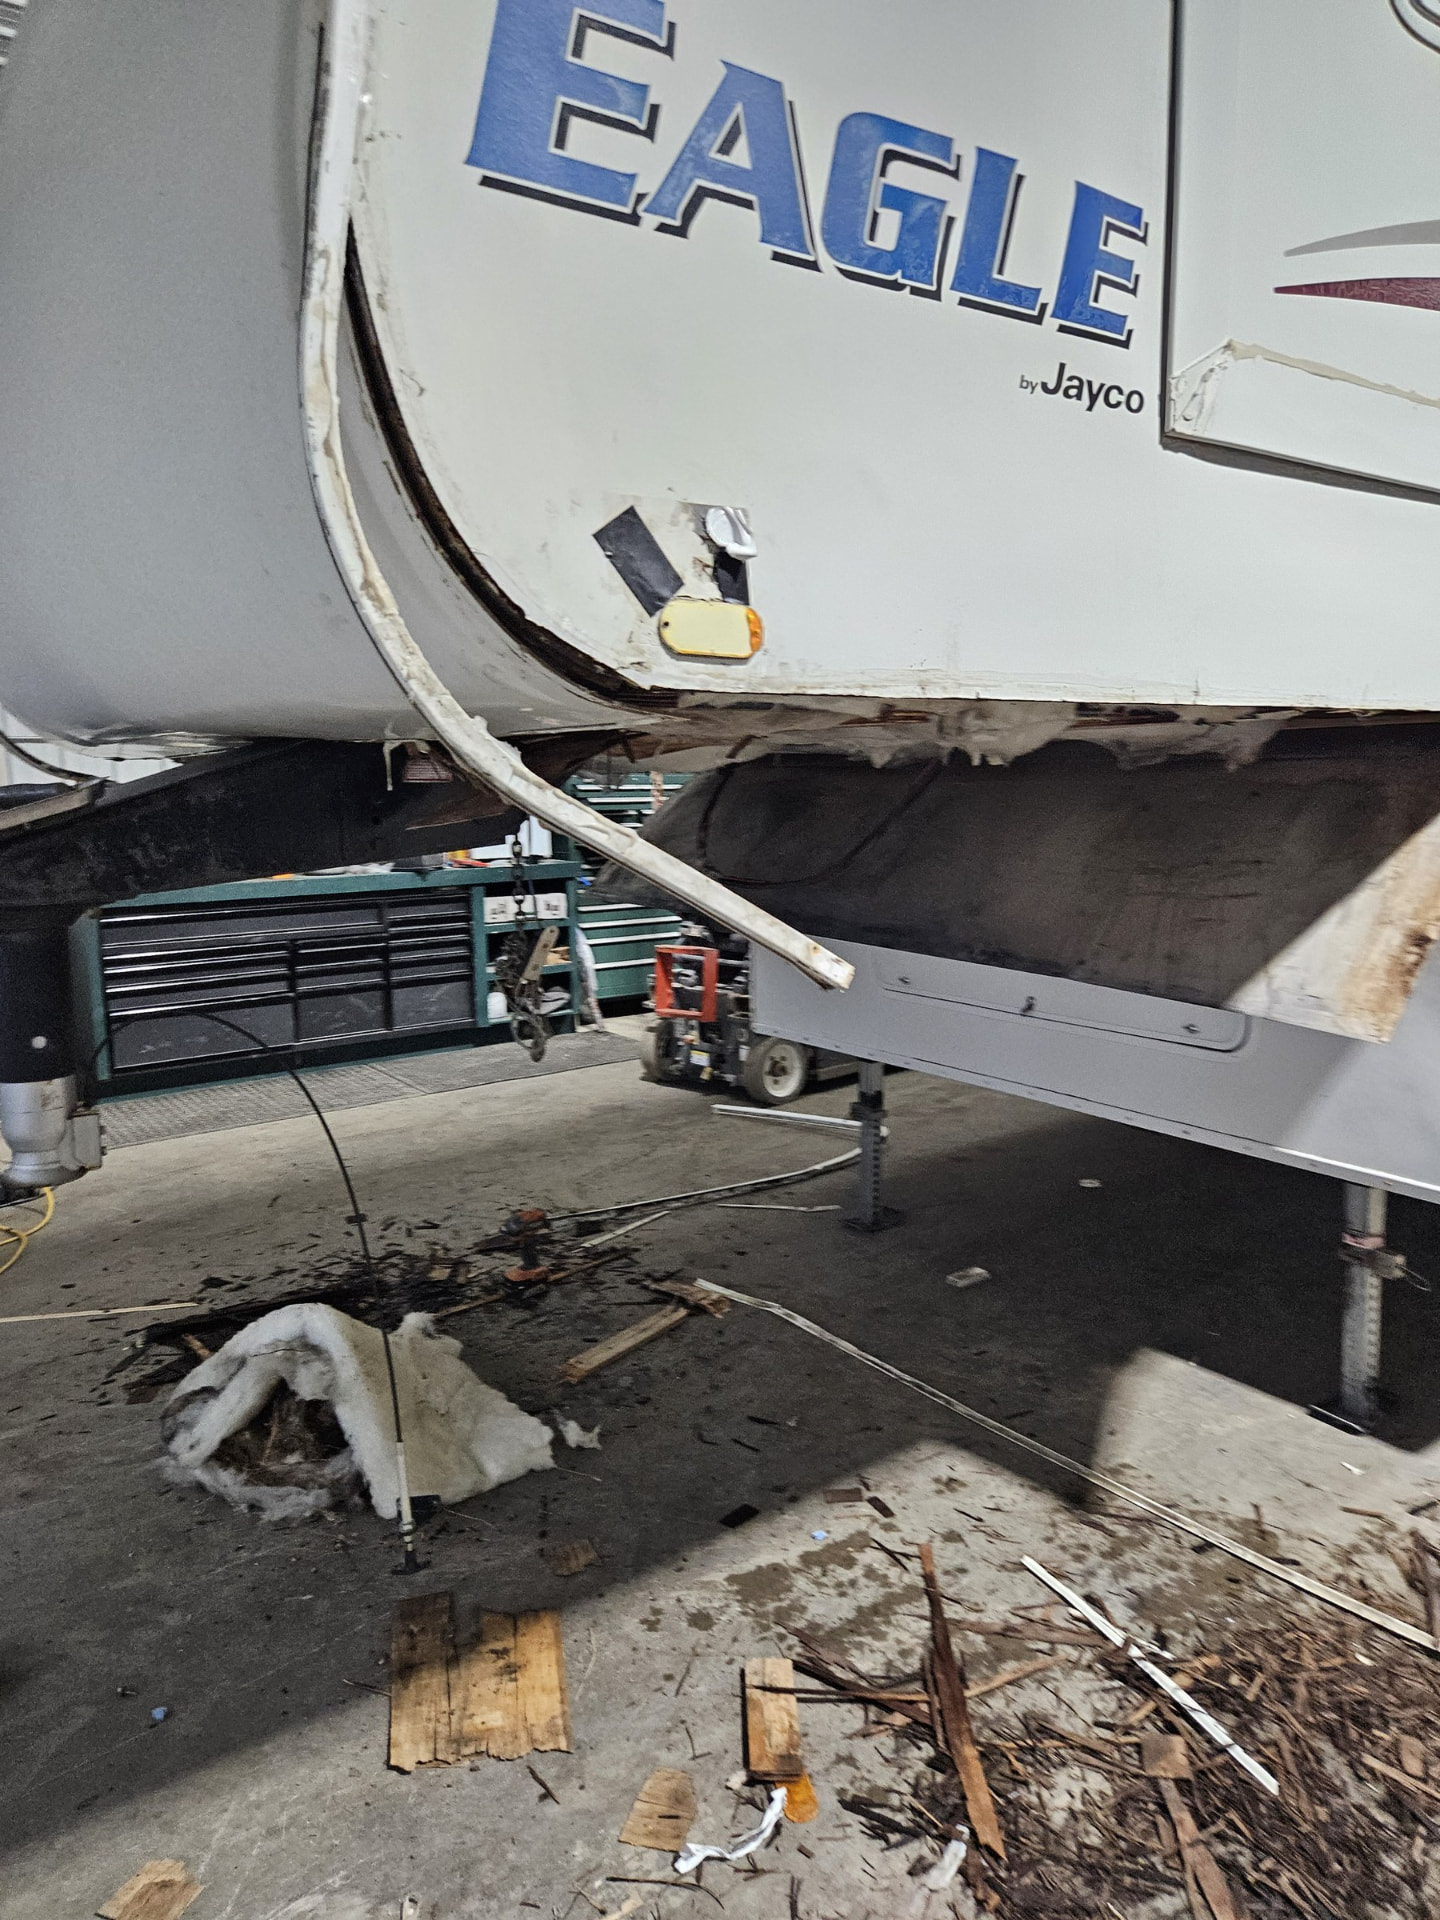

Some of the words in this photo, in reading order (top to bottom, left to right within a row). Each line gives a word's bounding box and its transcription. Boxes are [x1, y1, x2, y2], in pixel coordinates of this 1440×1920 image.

[464, 0, 1148, 348] EAGLE
[1019, 374, 1039, 395] by
[1040, 361, 1145, 414] Jayco
